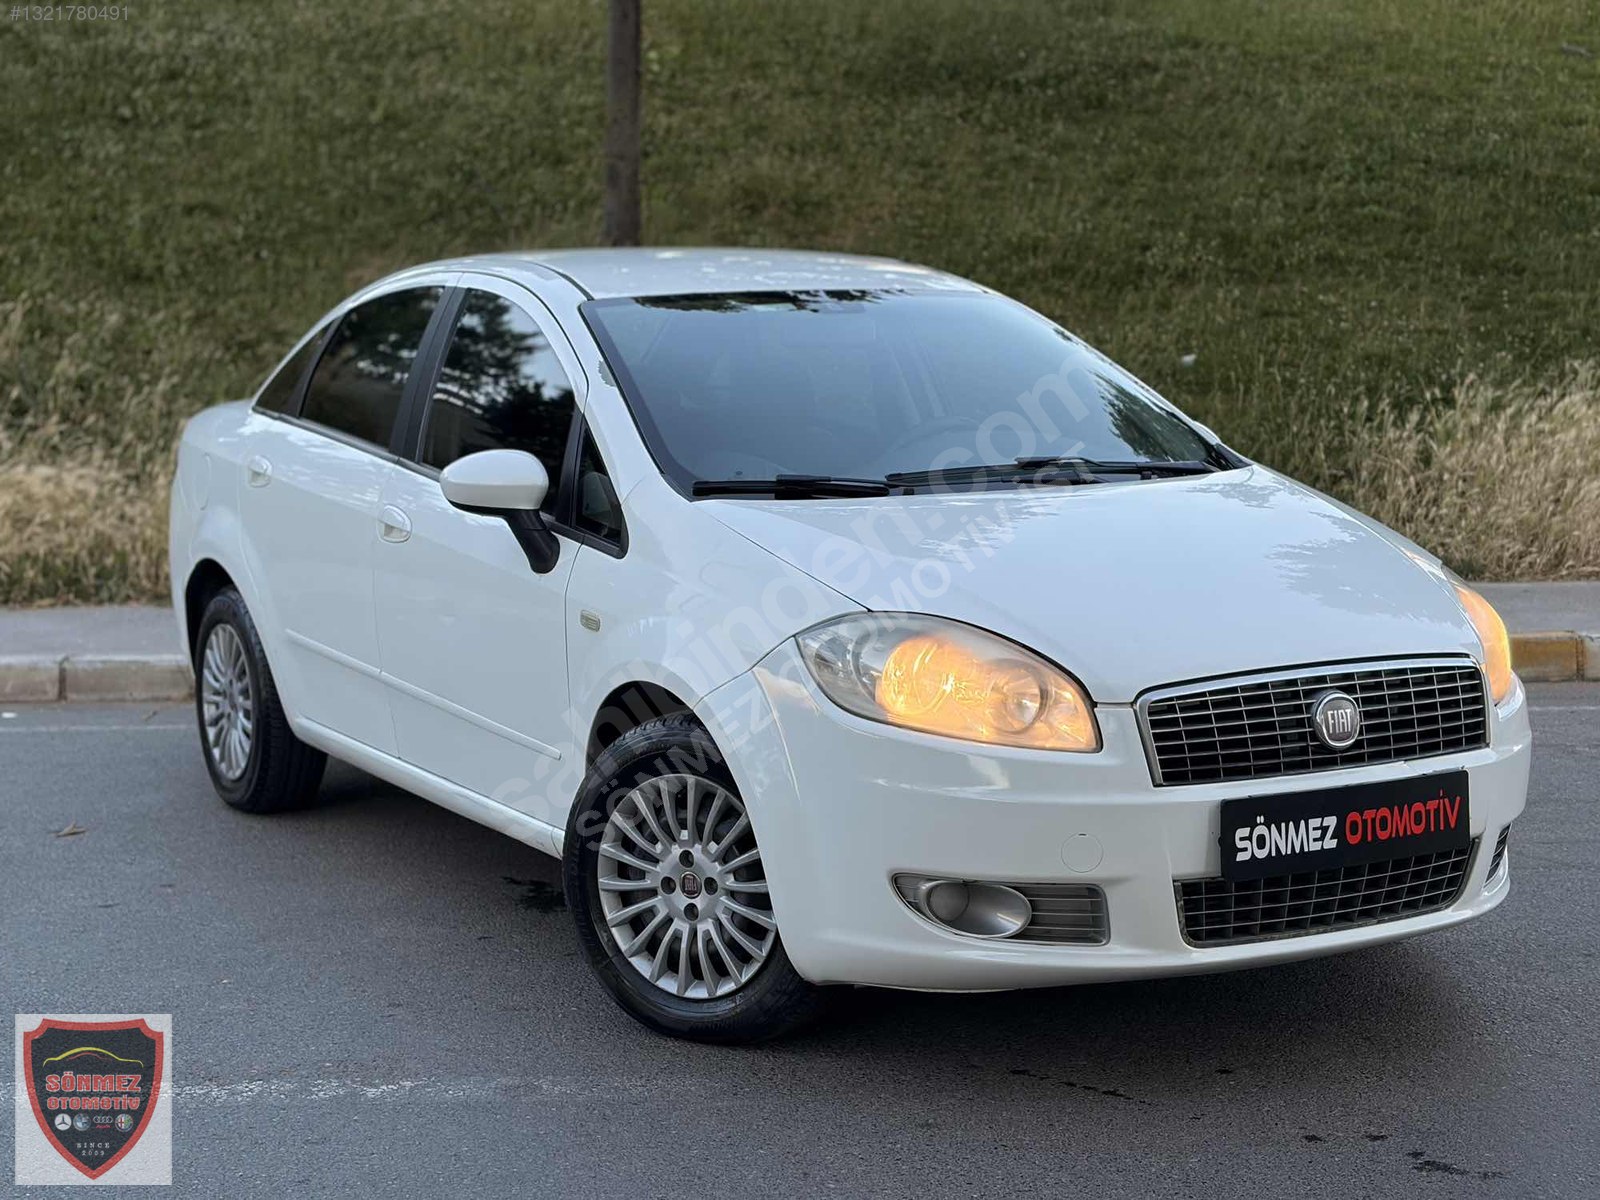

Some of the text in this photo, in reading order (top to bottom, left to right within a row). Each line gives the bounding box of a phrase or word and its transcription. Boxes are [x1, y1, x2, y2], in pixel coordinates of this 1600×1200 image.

[1327, 708, 1351, 734] FIAT
[1234, 789, 1461, 862] SÖNMEZ OTOMOTİV
